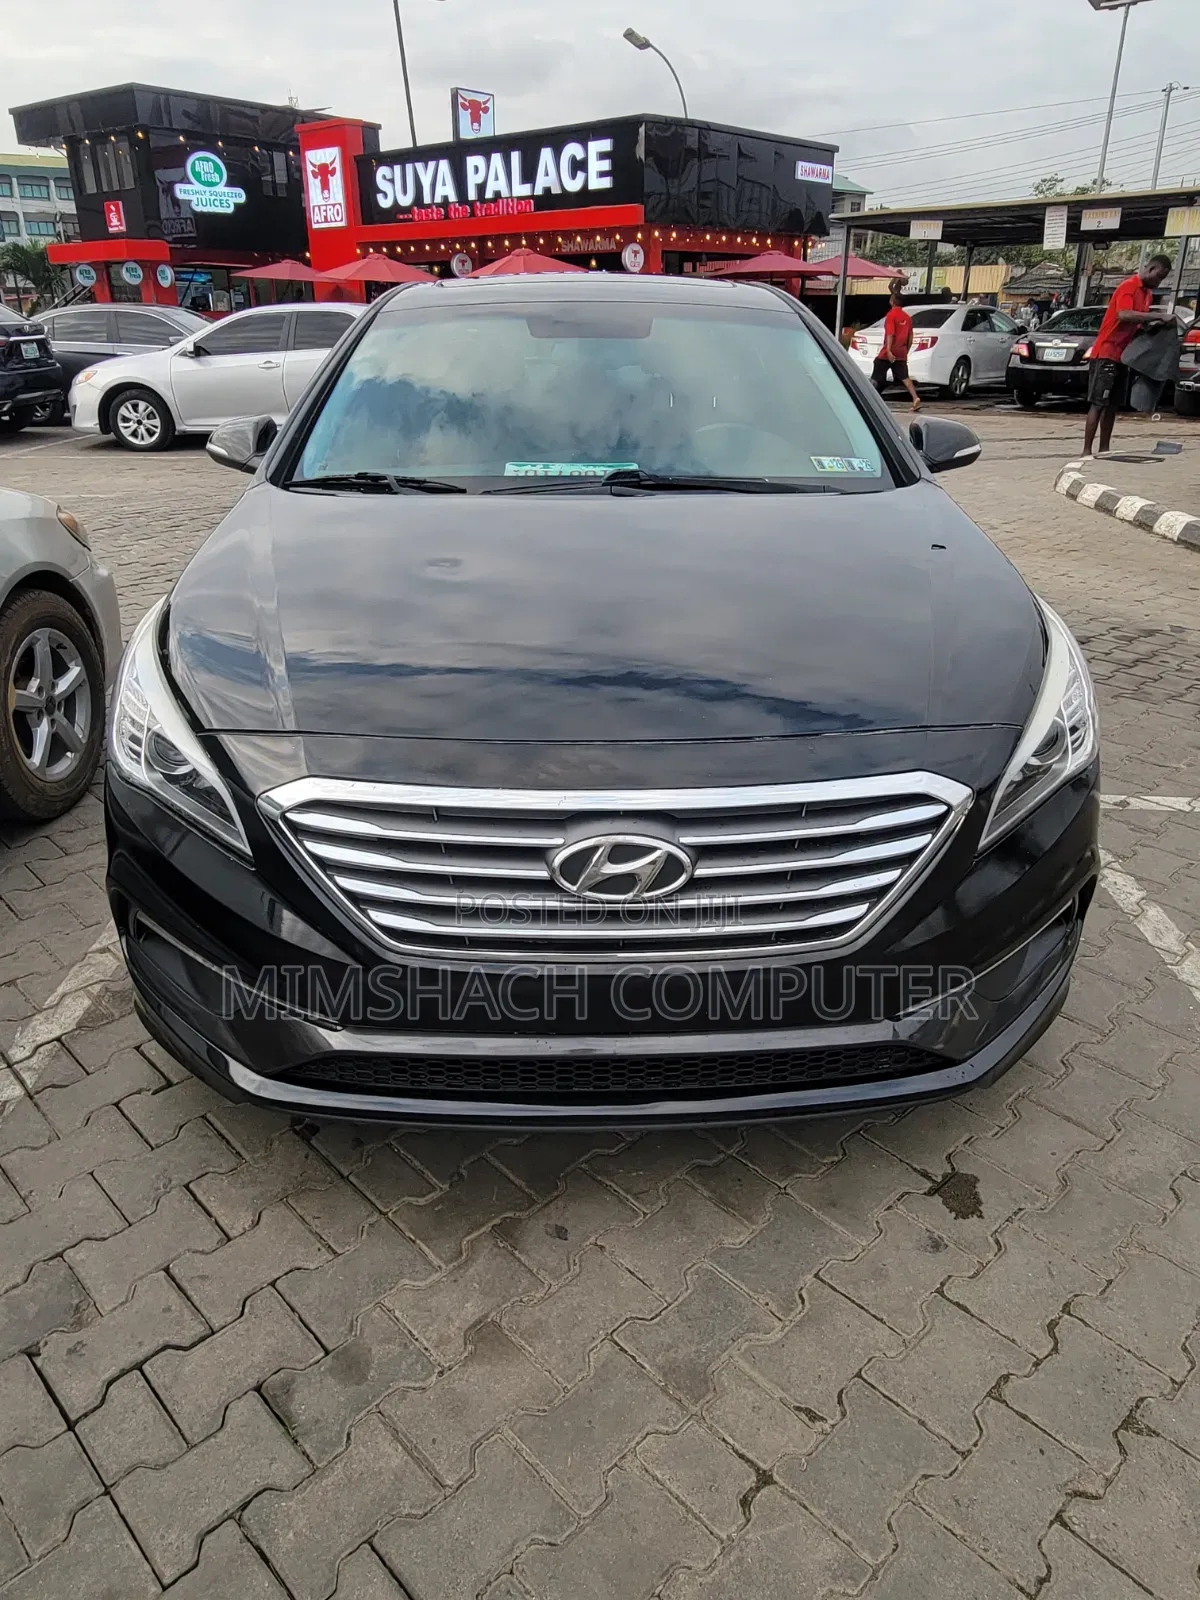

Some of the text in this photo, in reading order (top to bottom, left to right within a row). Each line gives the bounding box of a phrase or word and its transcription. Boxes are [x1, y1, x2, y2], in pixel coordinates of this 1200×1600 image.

[195, 160, 215, 173] AFRO
[375, 138, 613, 208] SUYA PALACE
[800, 165, 830, 180] SHAWARMA
[179, 188, 243, 198] FRESHLY SQUEEZED
[195, 197, 231, 208] JUICES
[447, 202, 471, 219] the
[473, 197, 535, 217] tradition
[313, 204, 343, 223] AFRO
[561, 238, 616, 252] SHAWARMA
